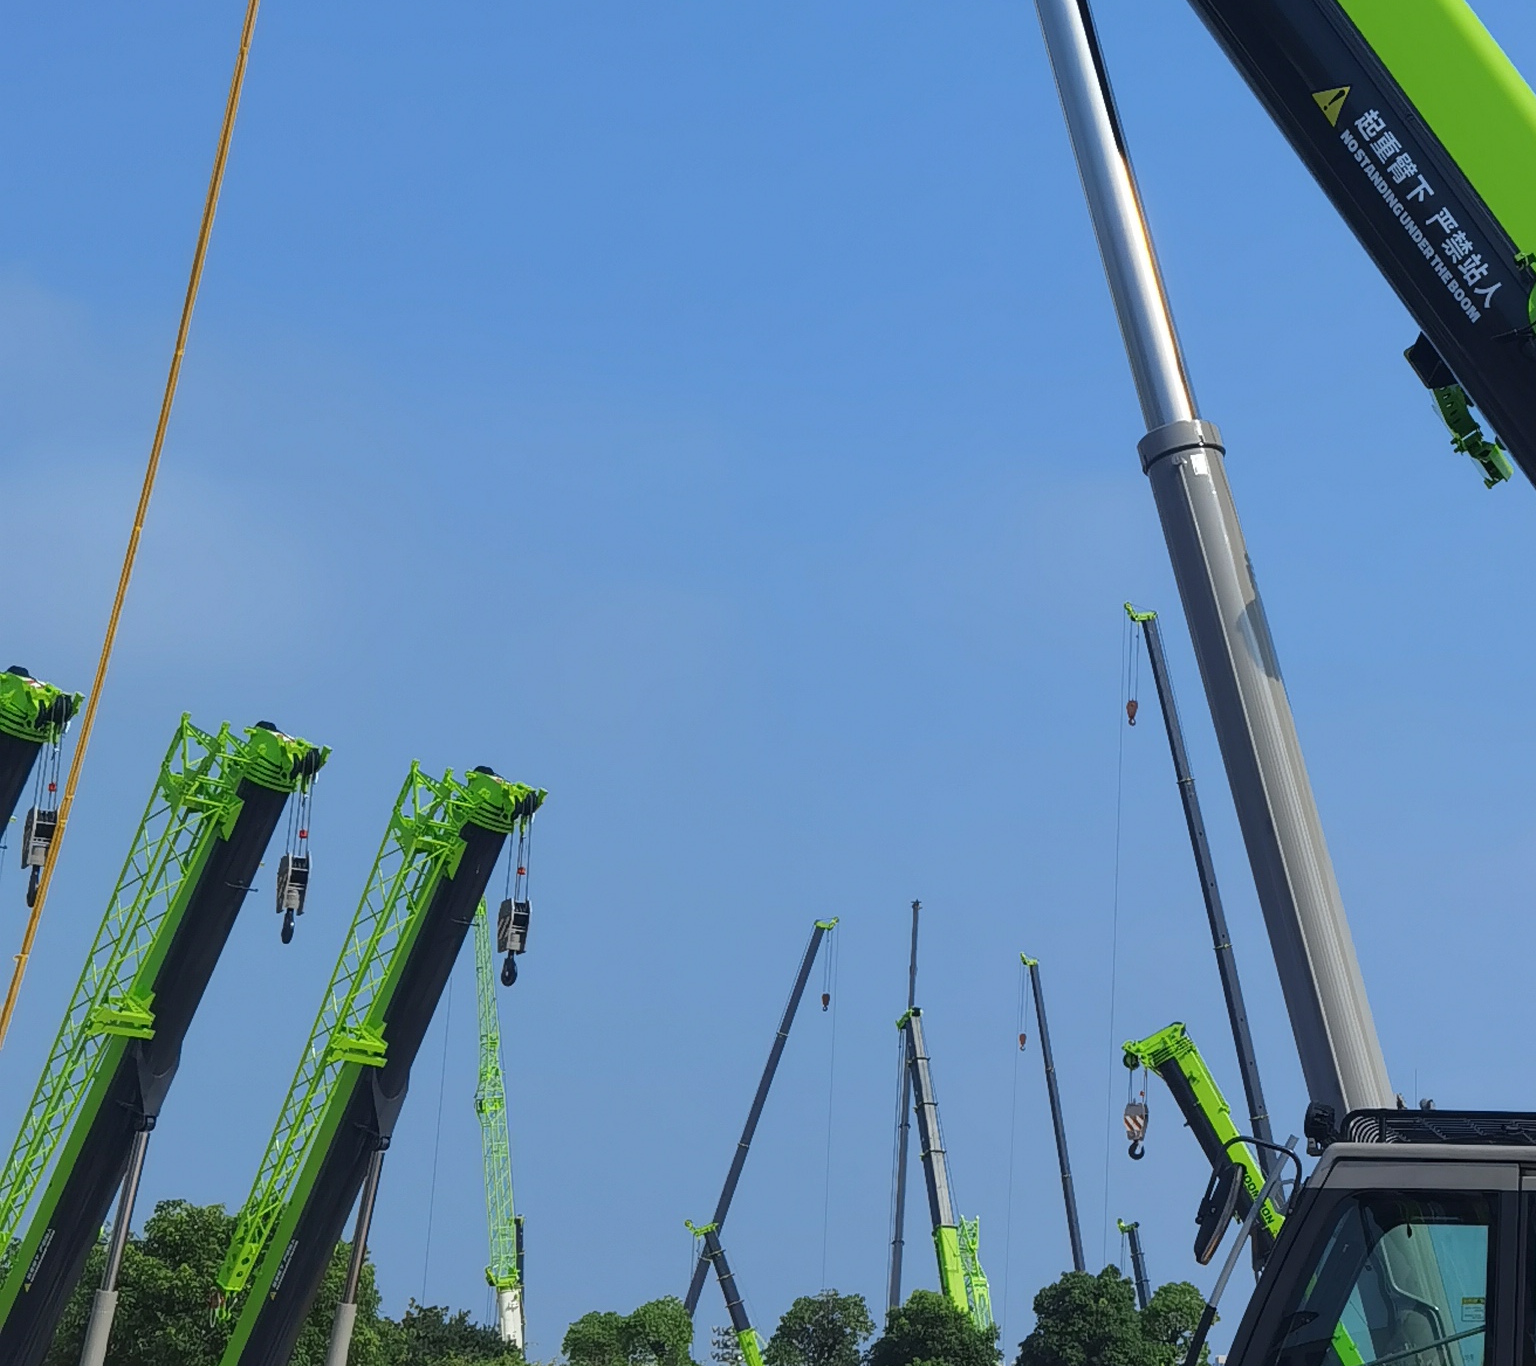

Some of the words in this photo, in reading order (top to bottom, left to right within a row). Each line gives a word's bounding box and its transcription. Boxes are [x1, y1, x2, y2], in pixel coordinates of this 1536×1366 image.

[1339, 128, 1359, 153] NO
[1353, 148, 1405, 217] STANDING
[1399, 210, 1436, 260] UNDER
[1429, 253, 1454, 285] THE
[1446, 278, 1482, 324] BOOM
[1353, 108, 1436, 205] 起重臂下
[1425, 206, 1503, 309] 严禁站人
